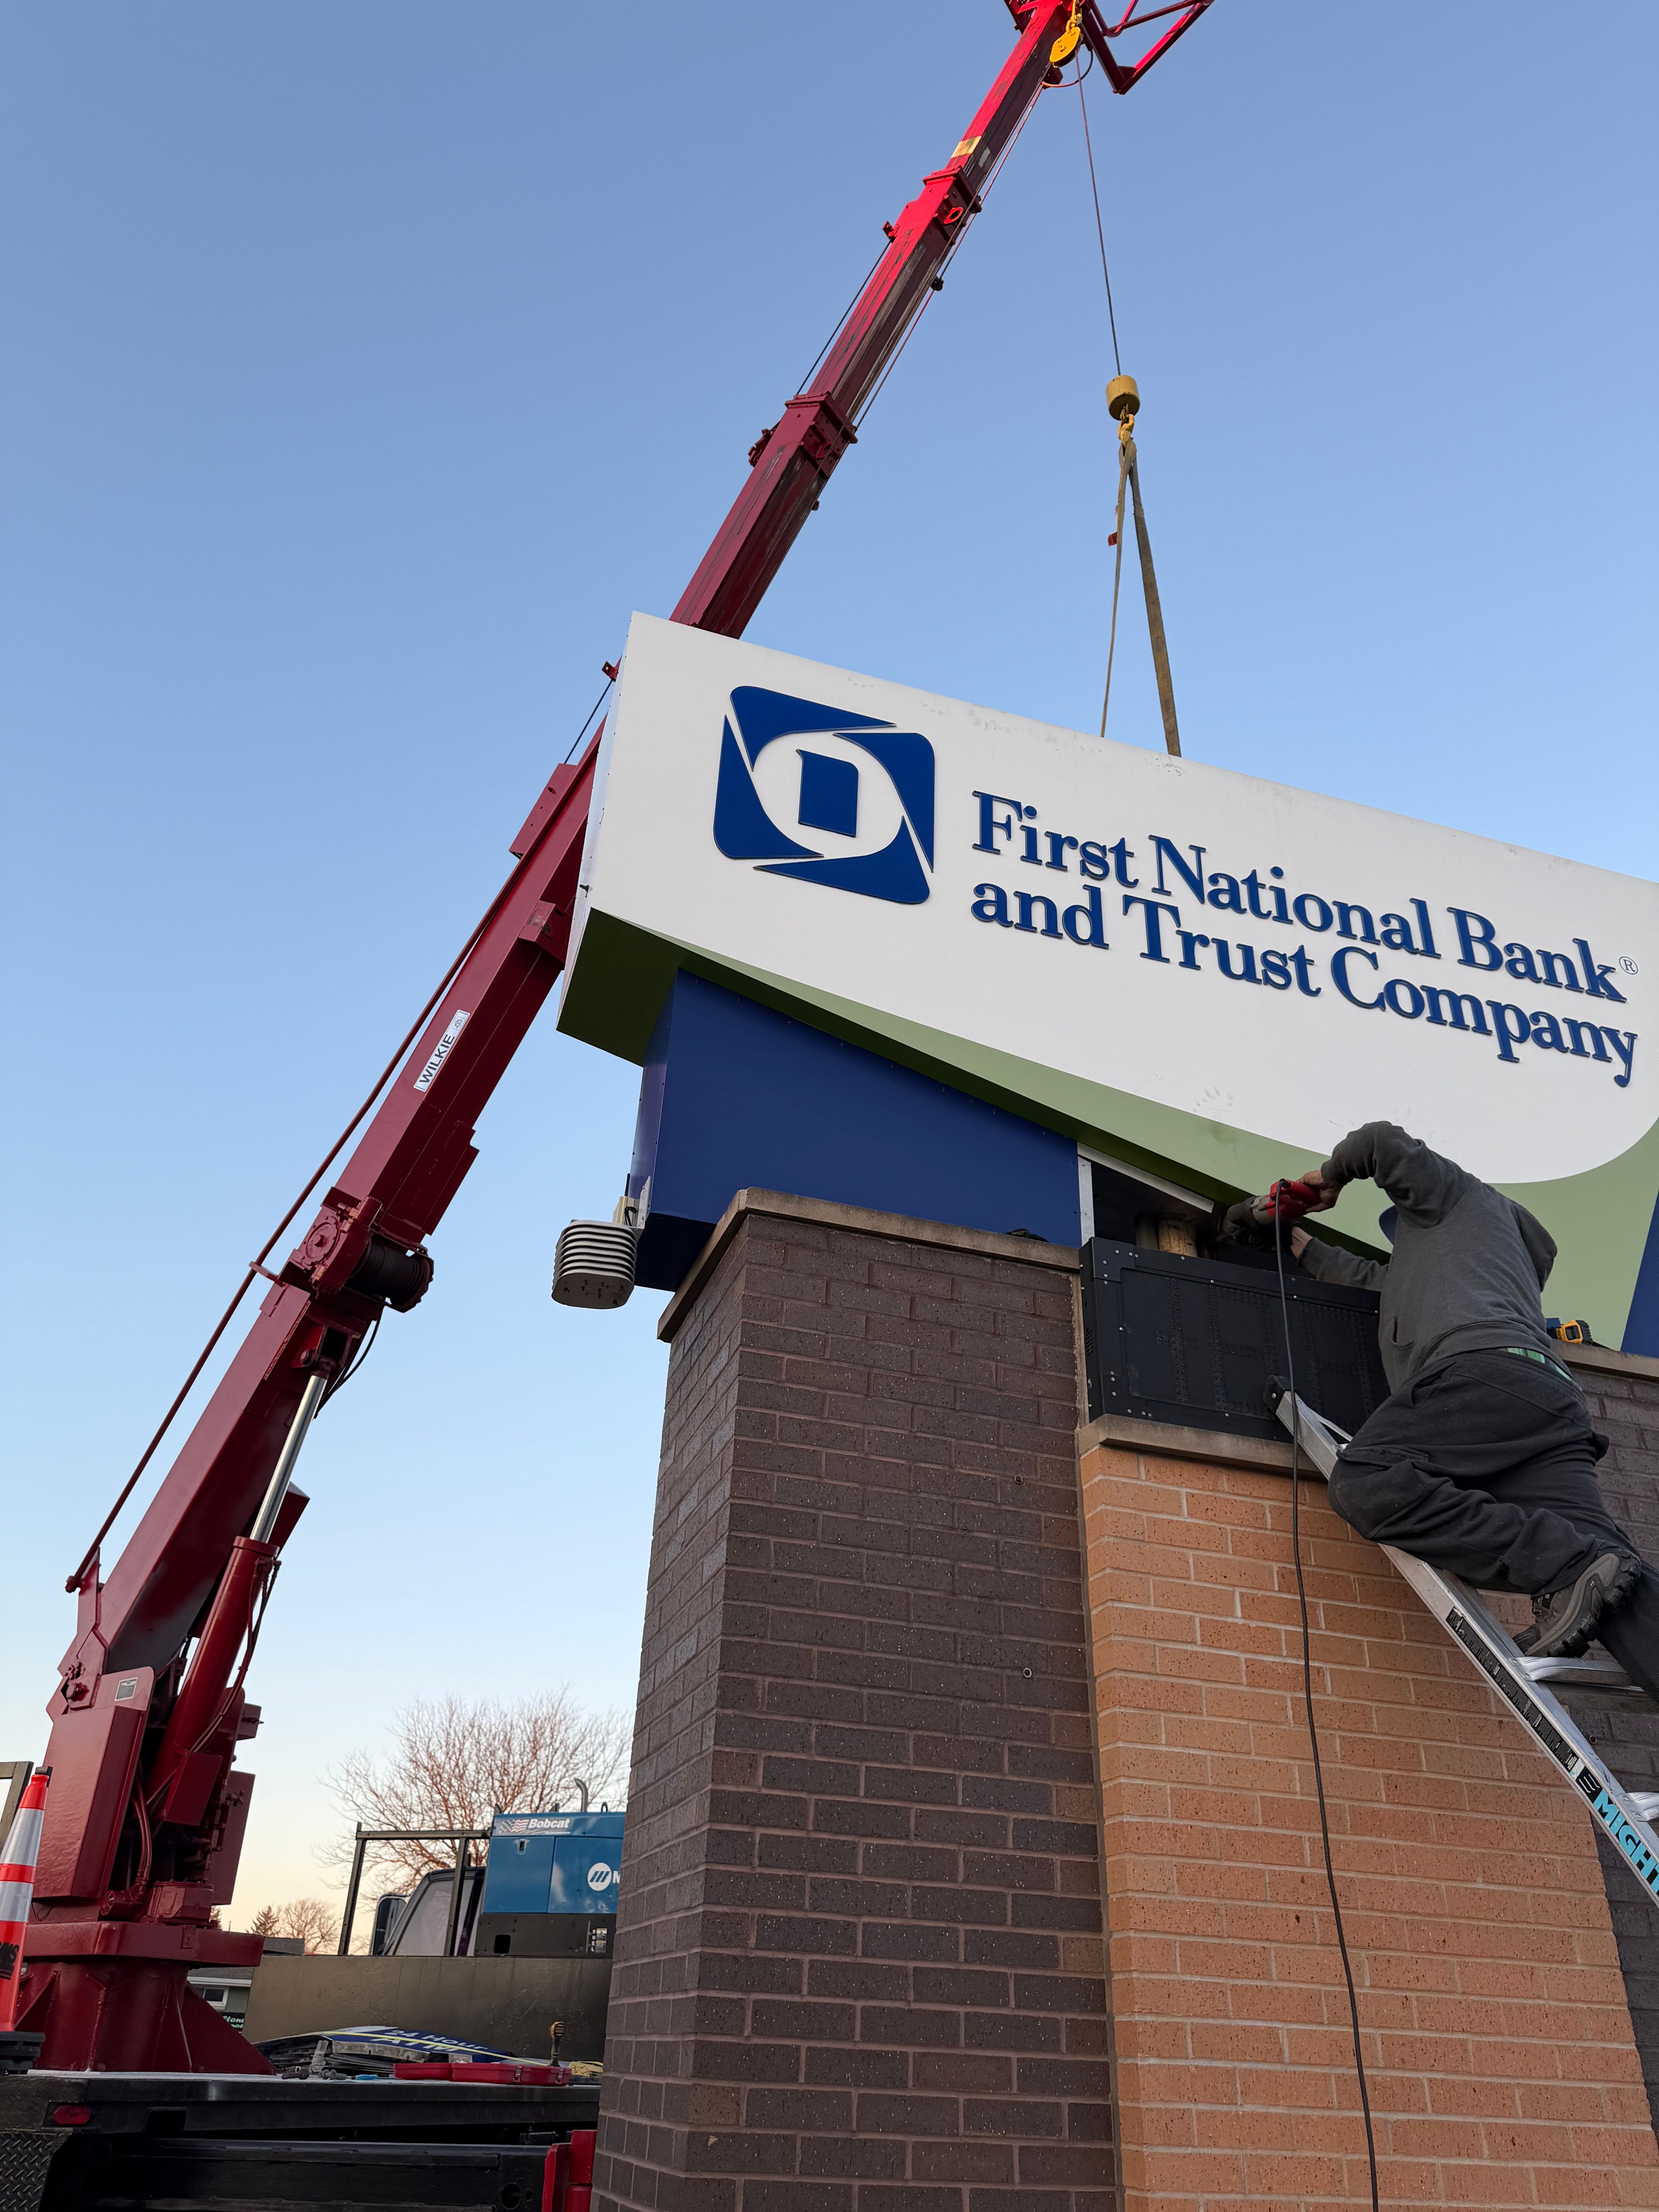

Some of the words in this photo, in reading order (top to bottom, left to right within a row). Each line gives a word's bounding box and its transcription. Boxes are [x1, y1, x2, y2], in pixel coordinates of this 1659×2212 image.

[972, 791, 1140, 888] First
[1149, 834, 1442, 959] National
[971, 883, 1110, 950] and
[1123, 893, 1322, 997] Trust
[1330, 945, 1638, 1087] Company
[419, 1034, 455, 1084] WILKIE
[527, 1818, 570, 1828] Bobcat
[422, 2035, 488, 2050] Hour
